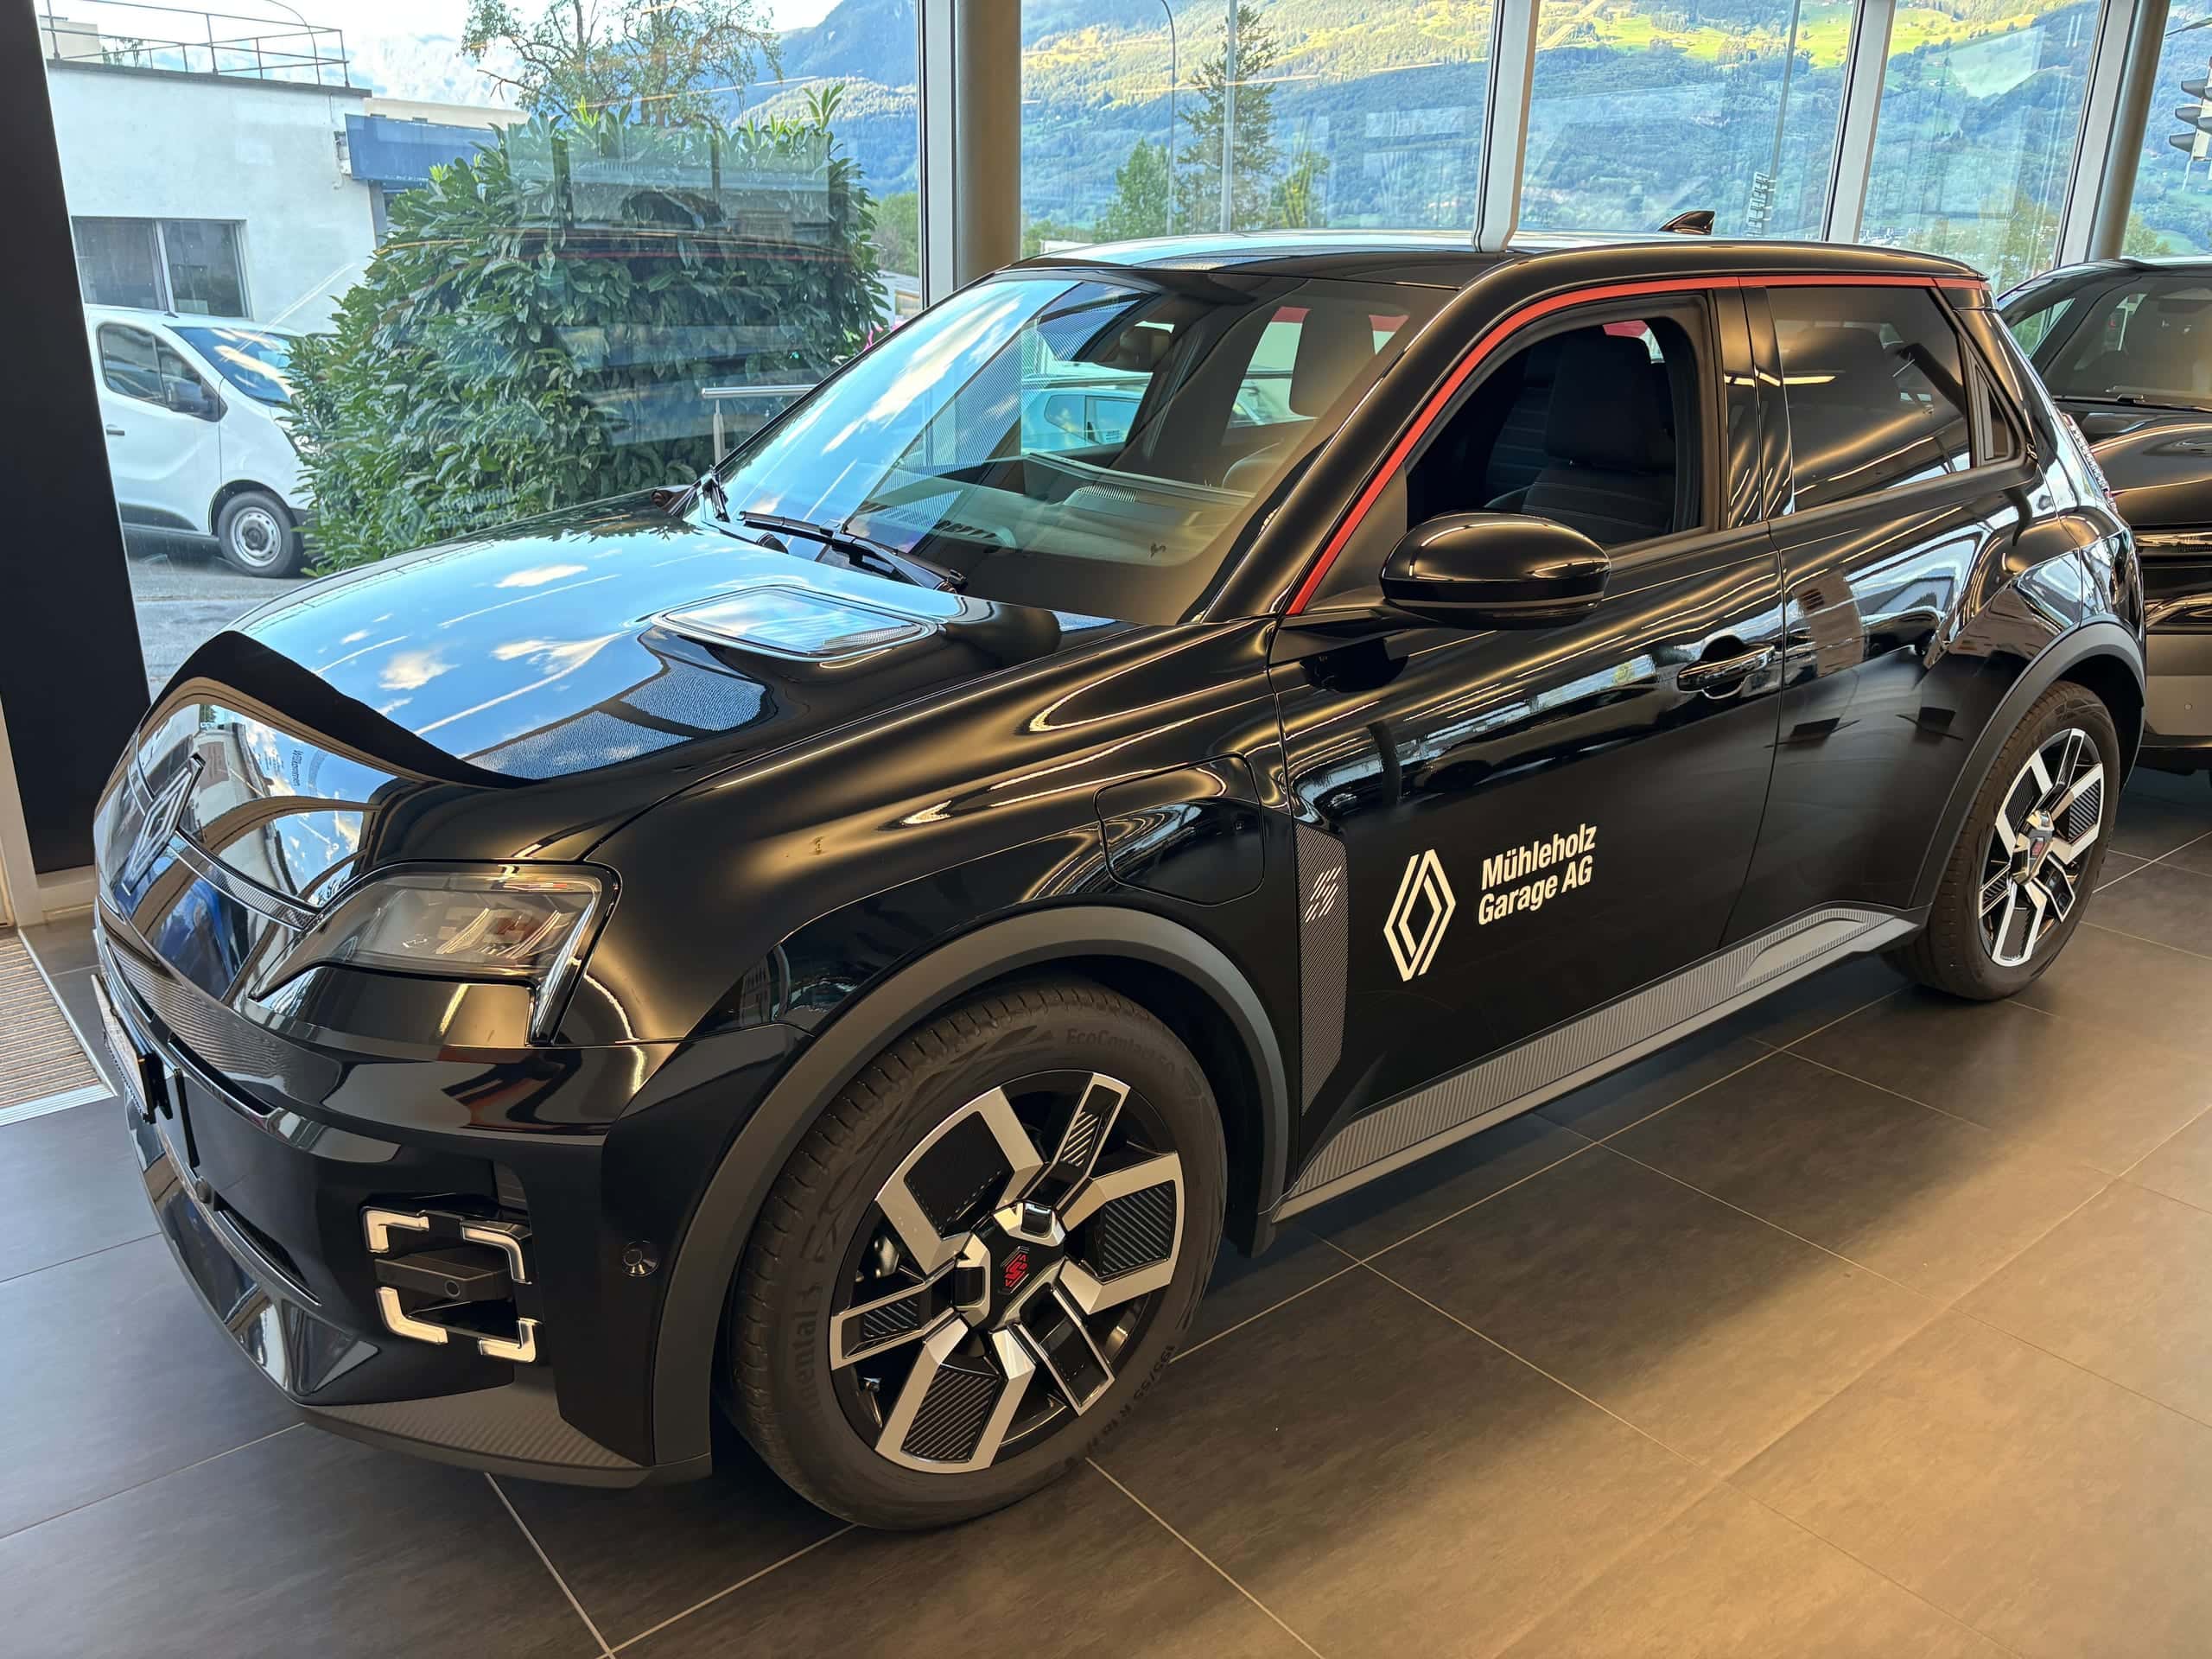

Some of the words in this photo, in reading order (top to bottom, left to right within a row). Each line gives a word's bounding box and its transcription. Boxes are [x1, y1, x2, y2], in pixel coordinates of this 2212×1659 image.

[1478, 874, 1559, 926] Garage
[1560, 855, 1593, 893] AG
[1480, 823, 1598, 891] Mühleholz
